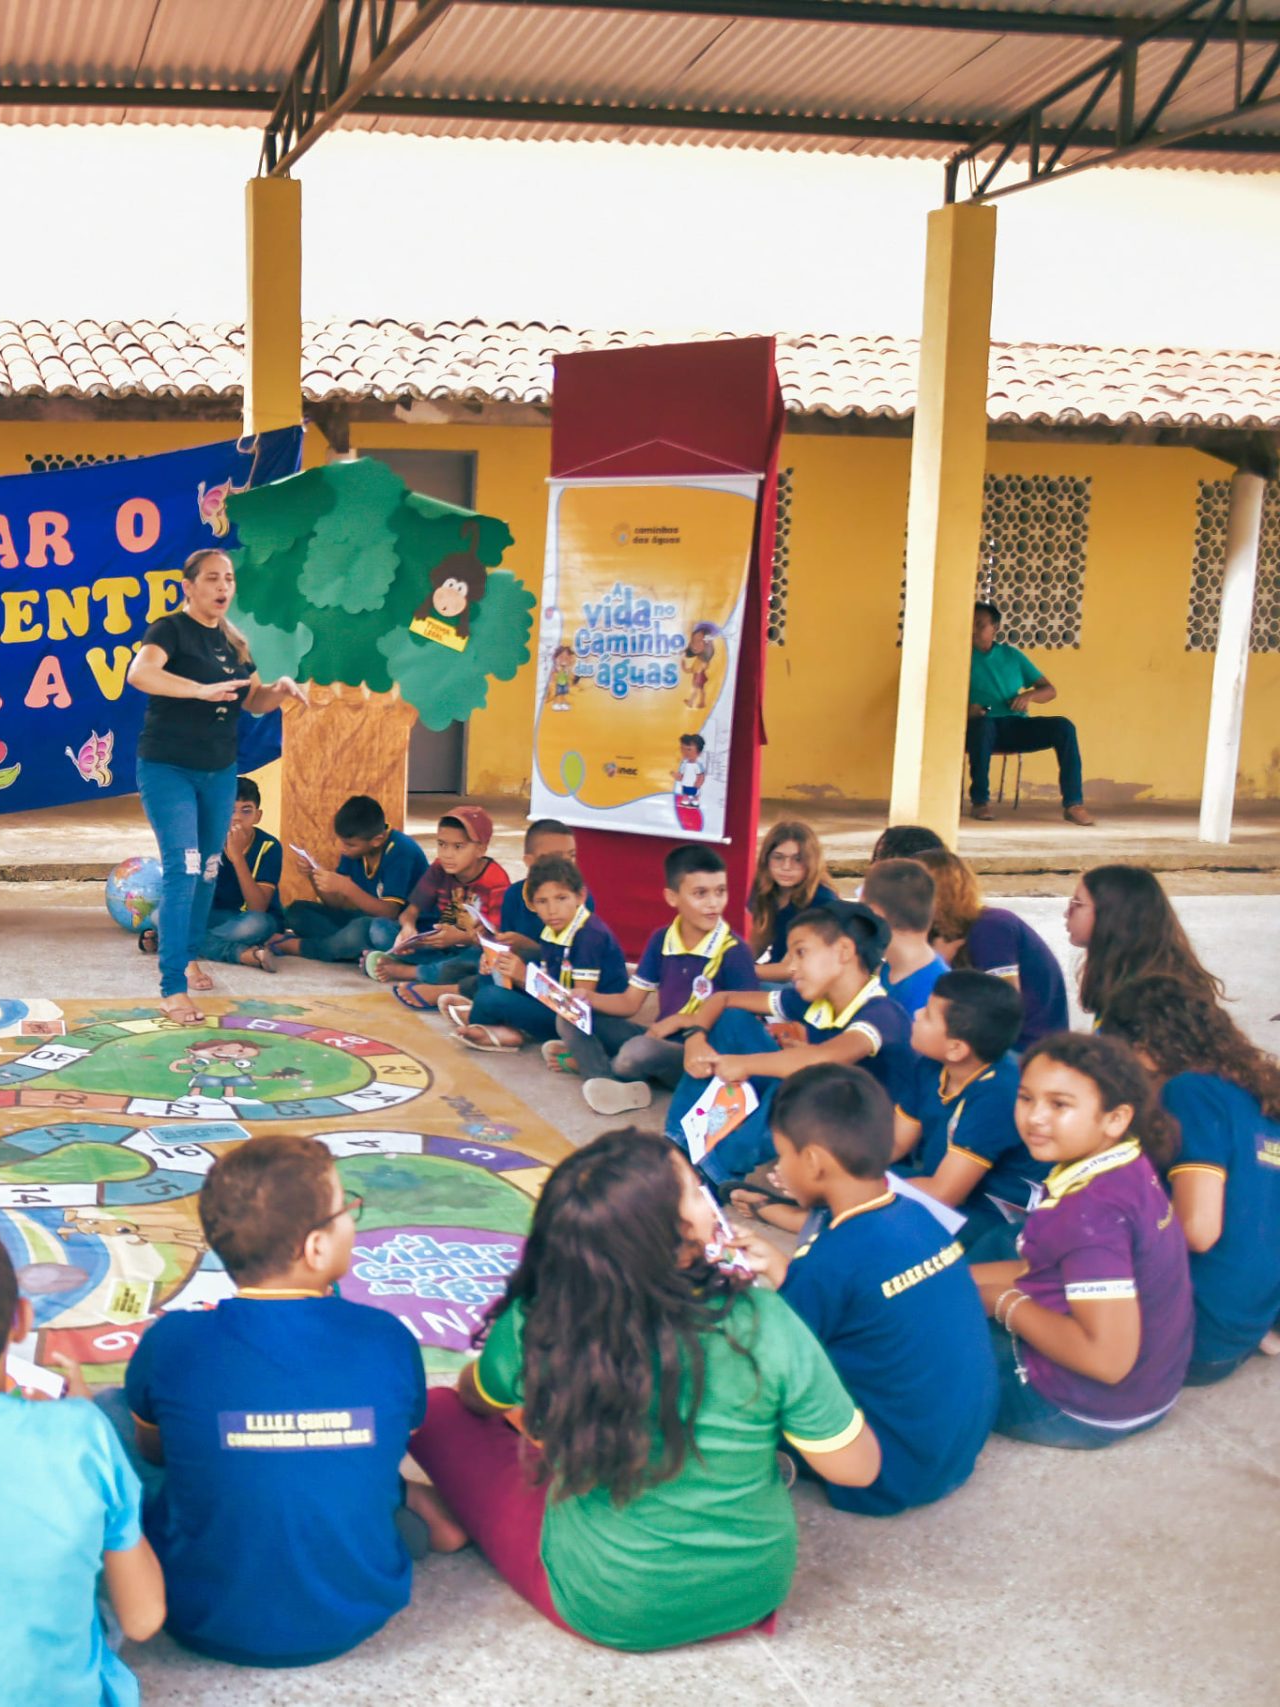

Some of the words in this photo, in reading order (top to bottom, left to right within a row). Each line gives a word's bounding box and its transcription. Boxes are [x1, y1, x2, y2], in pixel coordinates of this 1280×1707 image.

[116, 498, 160, 554] O
[583, 586, 652, 631] vida
[654, 603, 676, 619] no
[575, 621, 687, 658] Caminho
[24, 656, 72, 709] A
[595, 652, 679, 698] águas
[30, 1050, 76, 1062] 30
[378, 1065, 422, 1075] 25
[354, 1090, 402, 1104] 24
[165, 1102, 200, 1117] 22
[153, 1145, 203, 1159] 16
[459, 1148, 496, 1160] 3
[10, 1186, 51, 1206] 14
[136, 1179, 180, 1196] 15
[352, 1235, 481, 1264] vida
[353, 1255, 519, 1281] Caminh
[414, 1276, 507, 1304] águ
